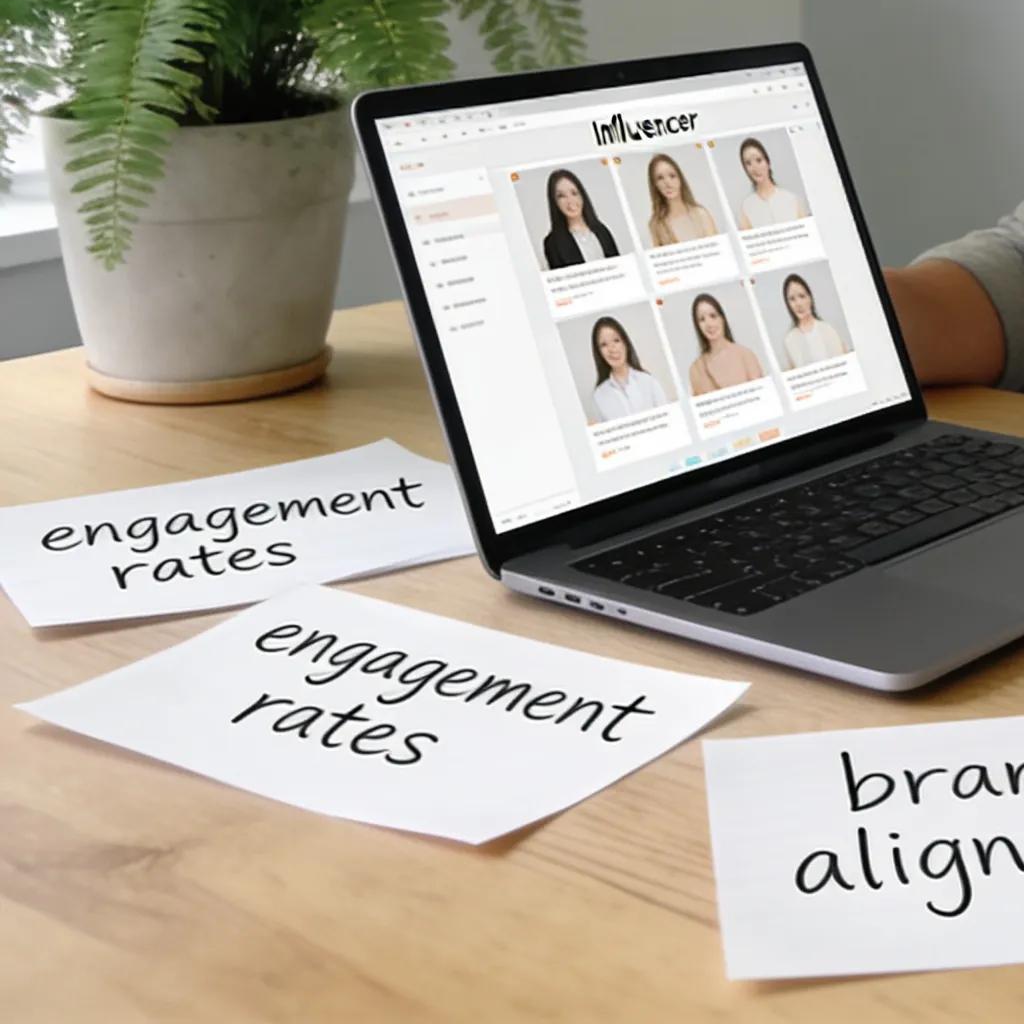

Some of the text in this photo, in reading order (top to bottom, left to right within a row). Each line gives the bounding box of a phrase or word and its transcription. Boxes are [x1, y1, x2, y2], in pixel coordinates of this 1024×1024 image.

[40, 475, 427, 553] engagement
[111, 540, 297, 590] rates
[255, 623, 656, 744] engagement
[231, 692, 440, 766] rates
